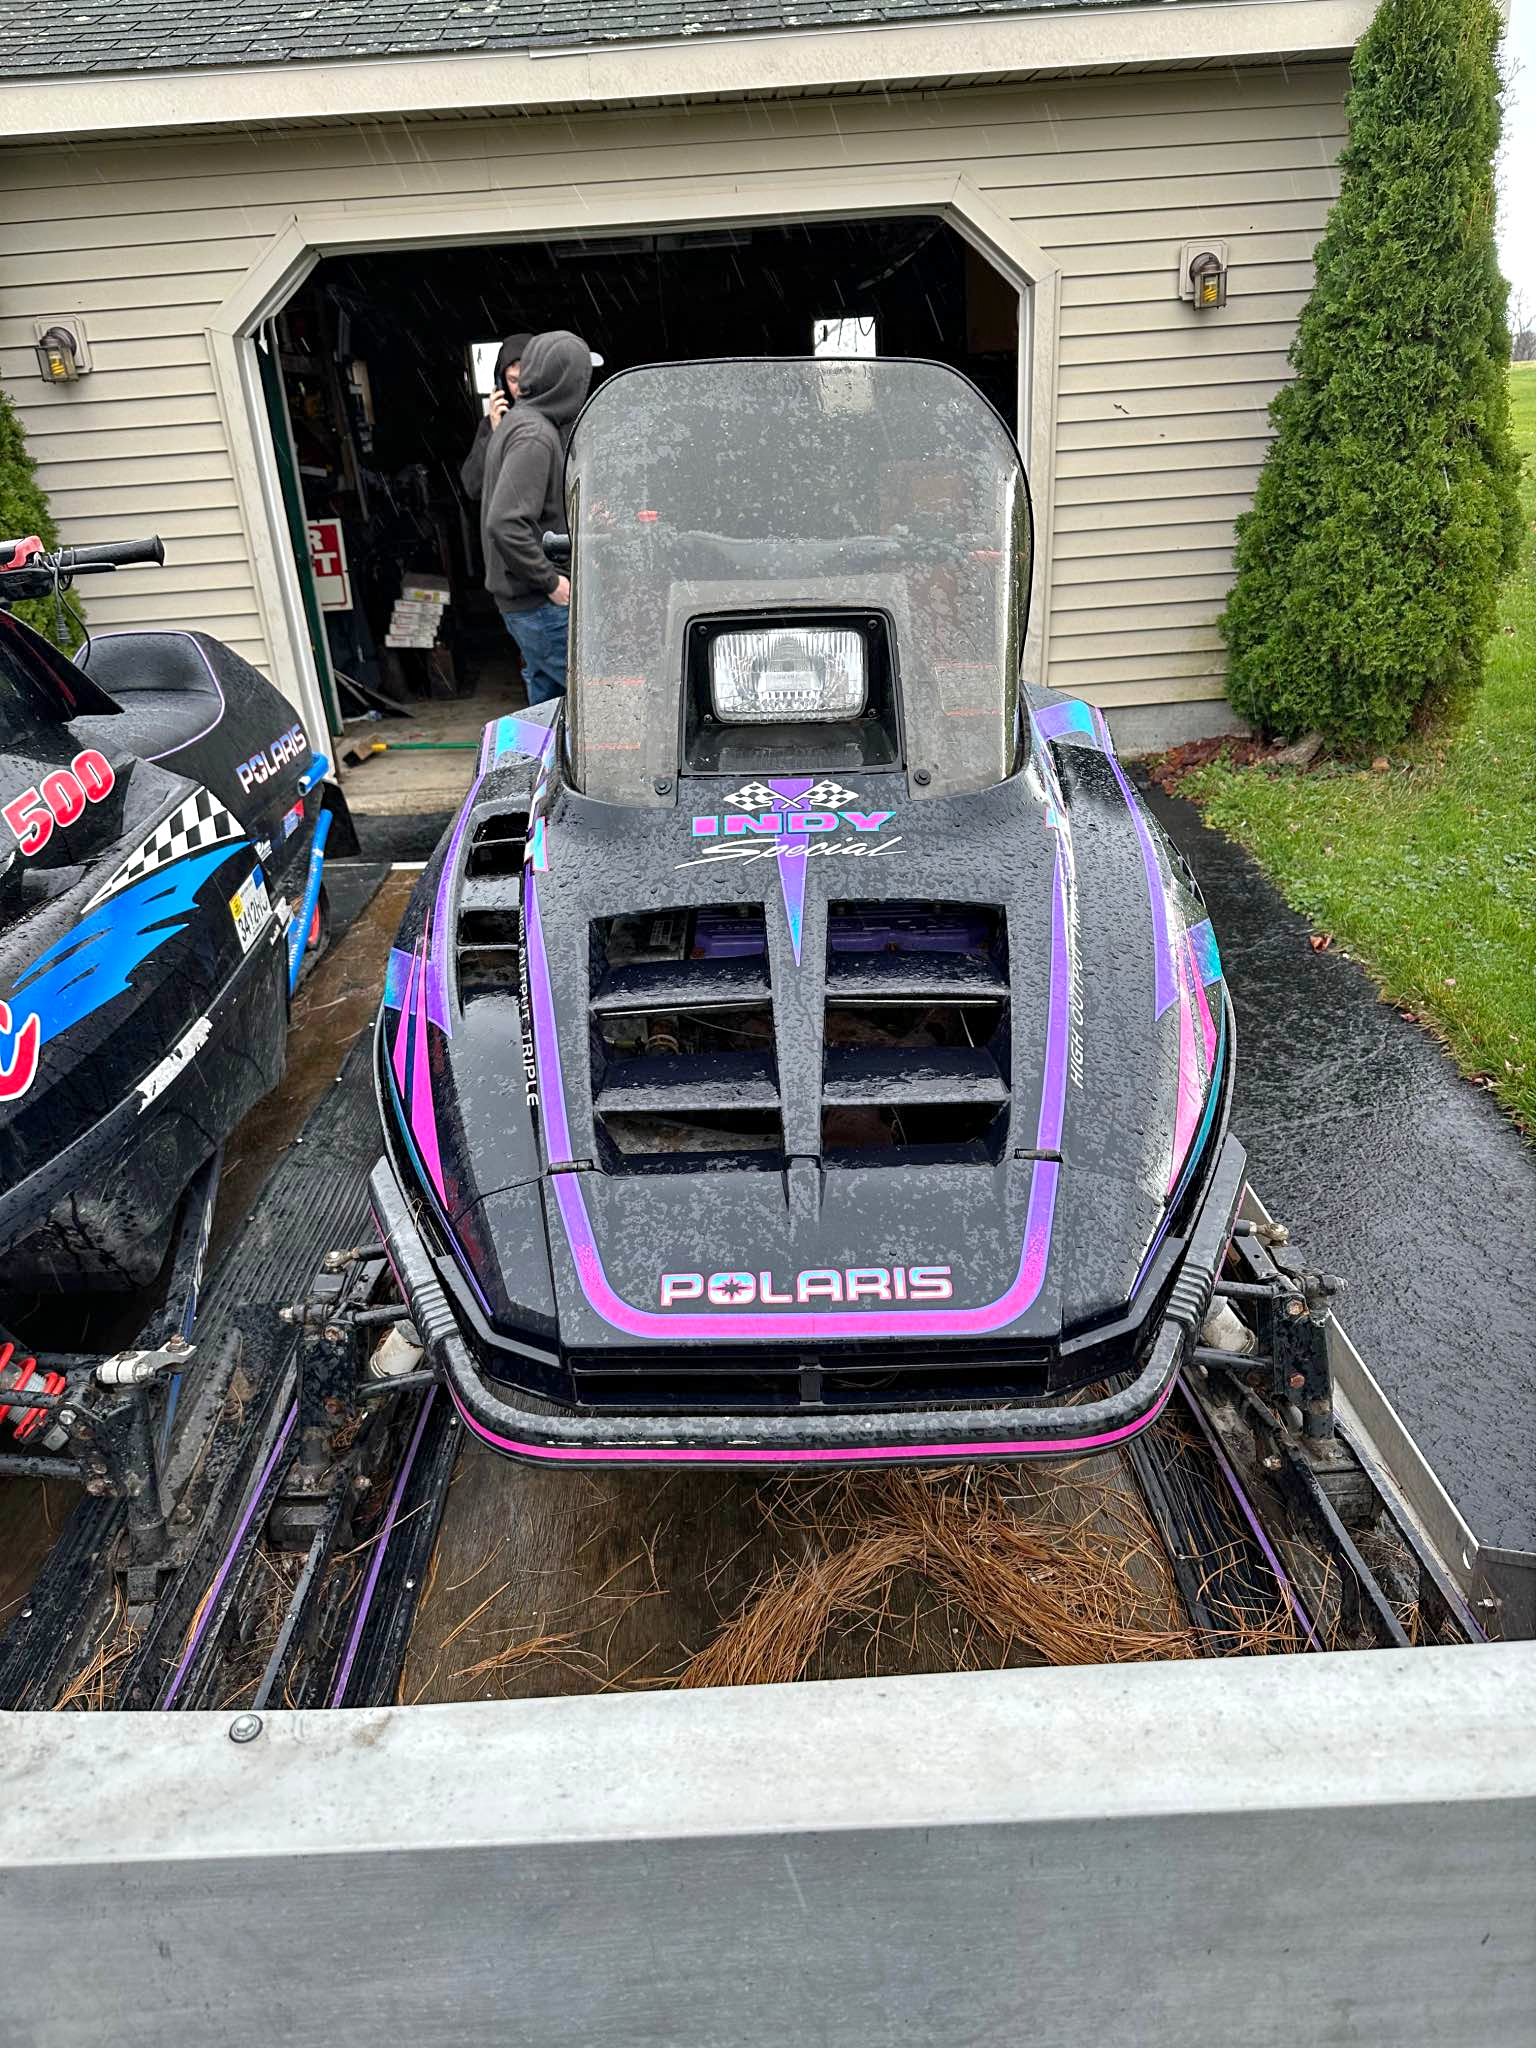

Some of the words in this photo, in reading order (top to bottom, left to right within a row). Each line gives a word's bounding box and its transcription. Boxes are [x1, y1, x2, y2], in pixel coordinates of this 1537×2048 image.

[236, 723, 307, 794] POLARIS
[1, 749, 115, 856] 500
[692, 811, 897, 837] INDY
[674, 836, 907, 870] Special
[519, 947, 531, 1021] OUTPUT
[1069, 943, 1084, 1026] OUTPUT
[522, 1029, 540, 1106] TRIPLE
[1070, 1027, 1084, 1089] HIGH
[660, 1265, 953, 1307] POLARIS
